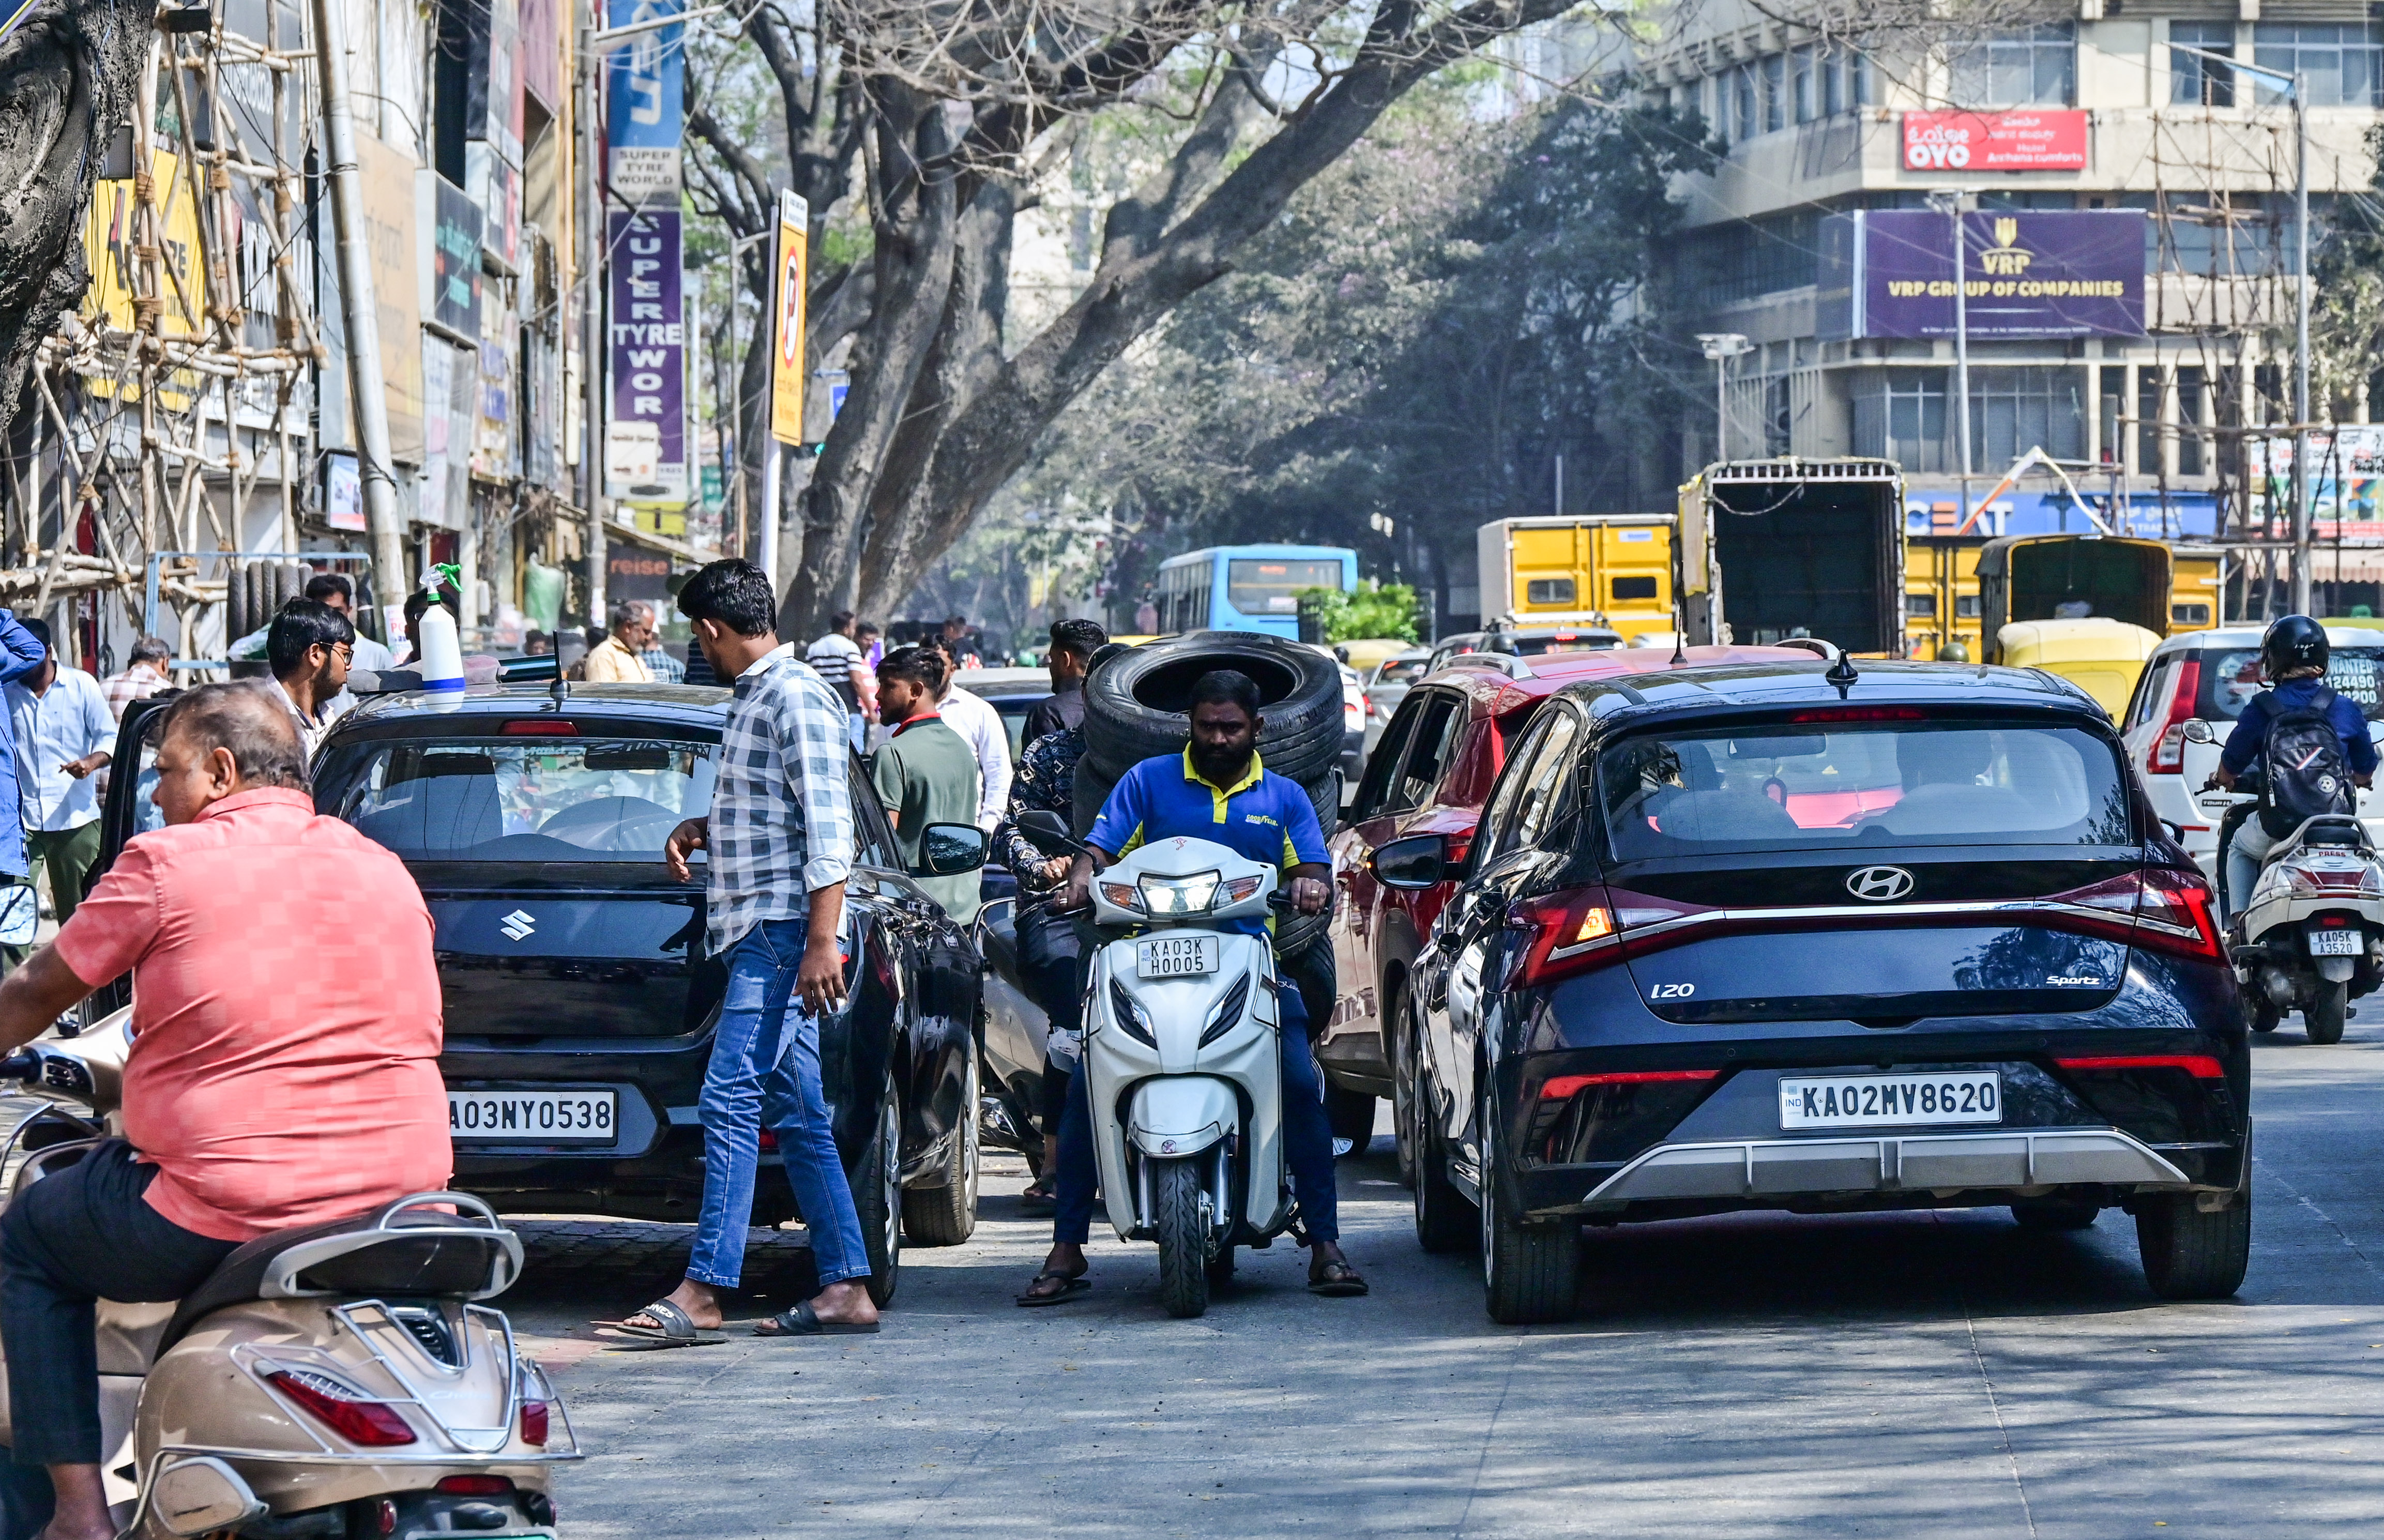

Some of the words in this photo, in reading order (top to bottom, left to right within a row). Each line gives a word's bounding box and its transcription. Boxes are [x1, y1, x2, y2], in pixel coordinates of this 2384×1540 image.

[619, 151, 671, 159] SUPER
[1908, 144, 1970, 167] OYO
[625, 163, 665, 172] TYRE
[617, 176, 673, 184] WORLD
[631, 215, 661, 318] SUPER
[1983, 255, 2030, 275] VRP
[1888, 281, 1925, 297] VRP
[1993, 281, 2016, 297] OF
[2018, 281, 2123, 297] COMPANIES
[613, 324, 681, 345] TYRE
[2329, 659, 2373, 674] WANTED
[2318, 931, 2351, 942] KA05K
[1151, 939, 1203, 957] KA03K
[2320, 943, 2352, 954] A3520
[1152, 956, 1203, 974] H0005
[2046, 975, 2100, 986] Sportz
[1785, 1099, 1801, 1107] IND
[1803, 1082, 1995, 1117] KA02MV8620
